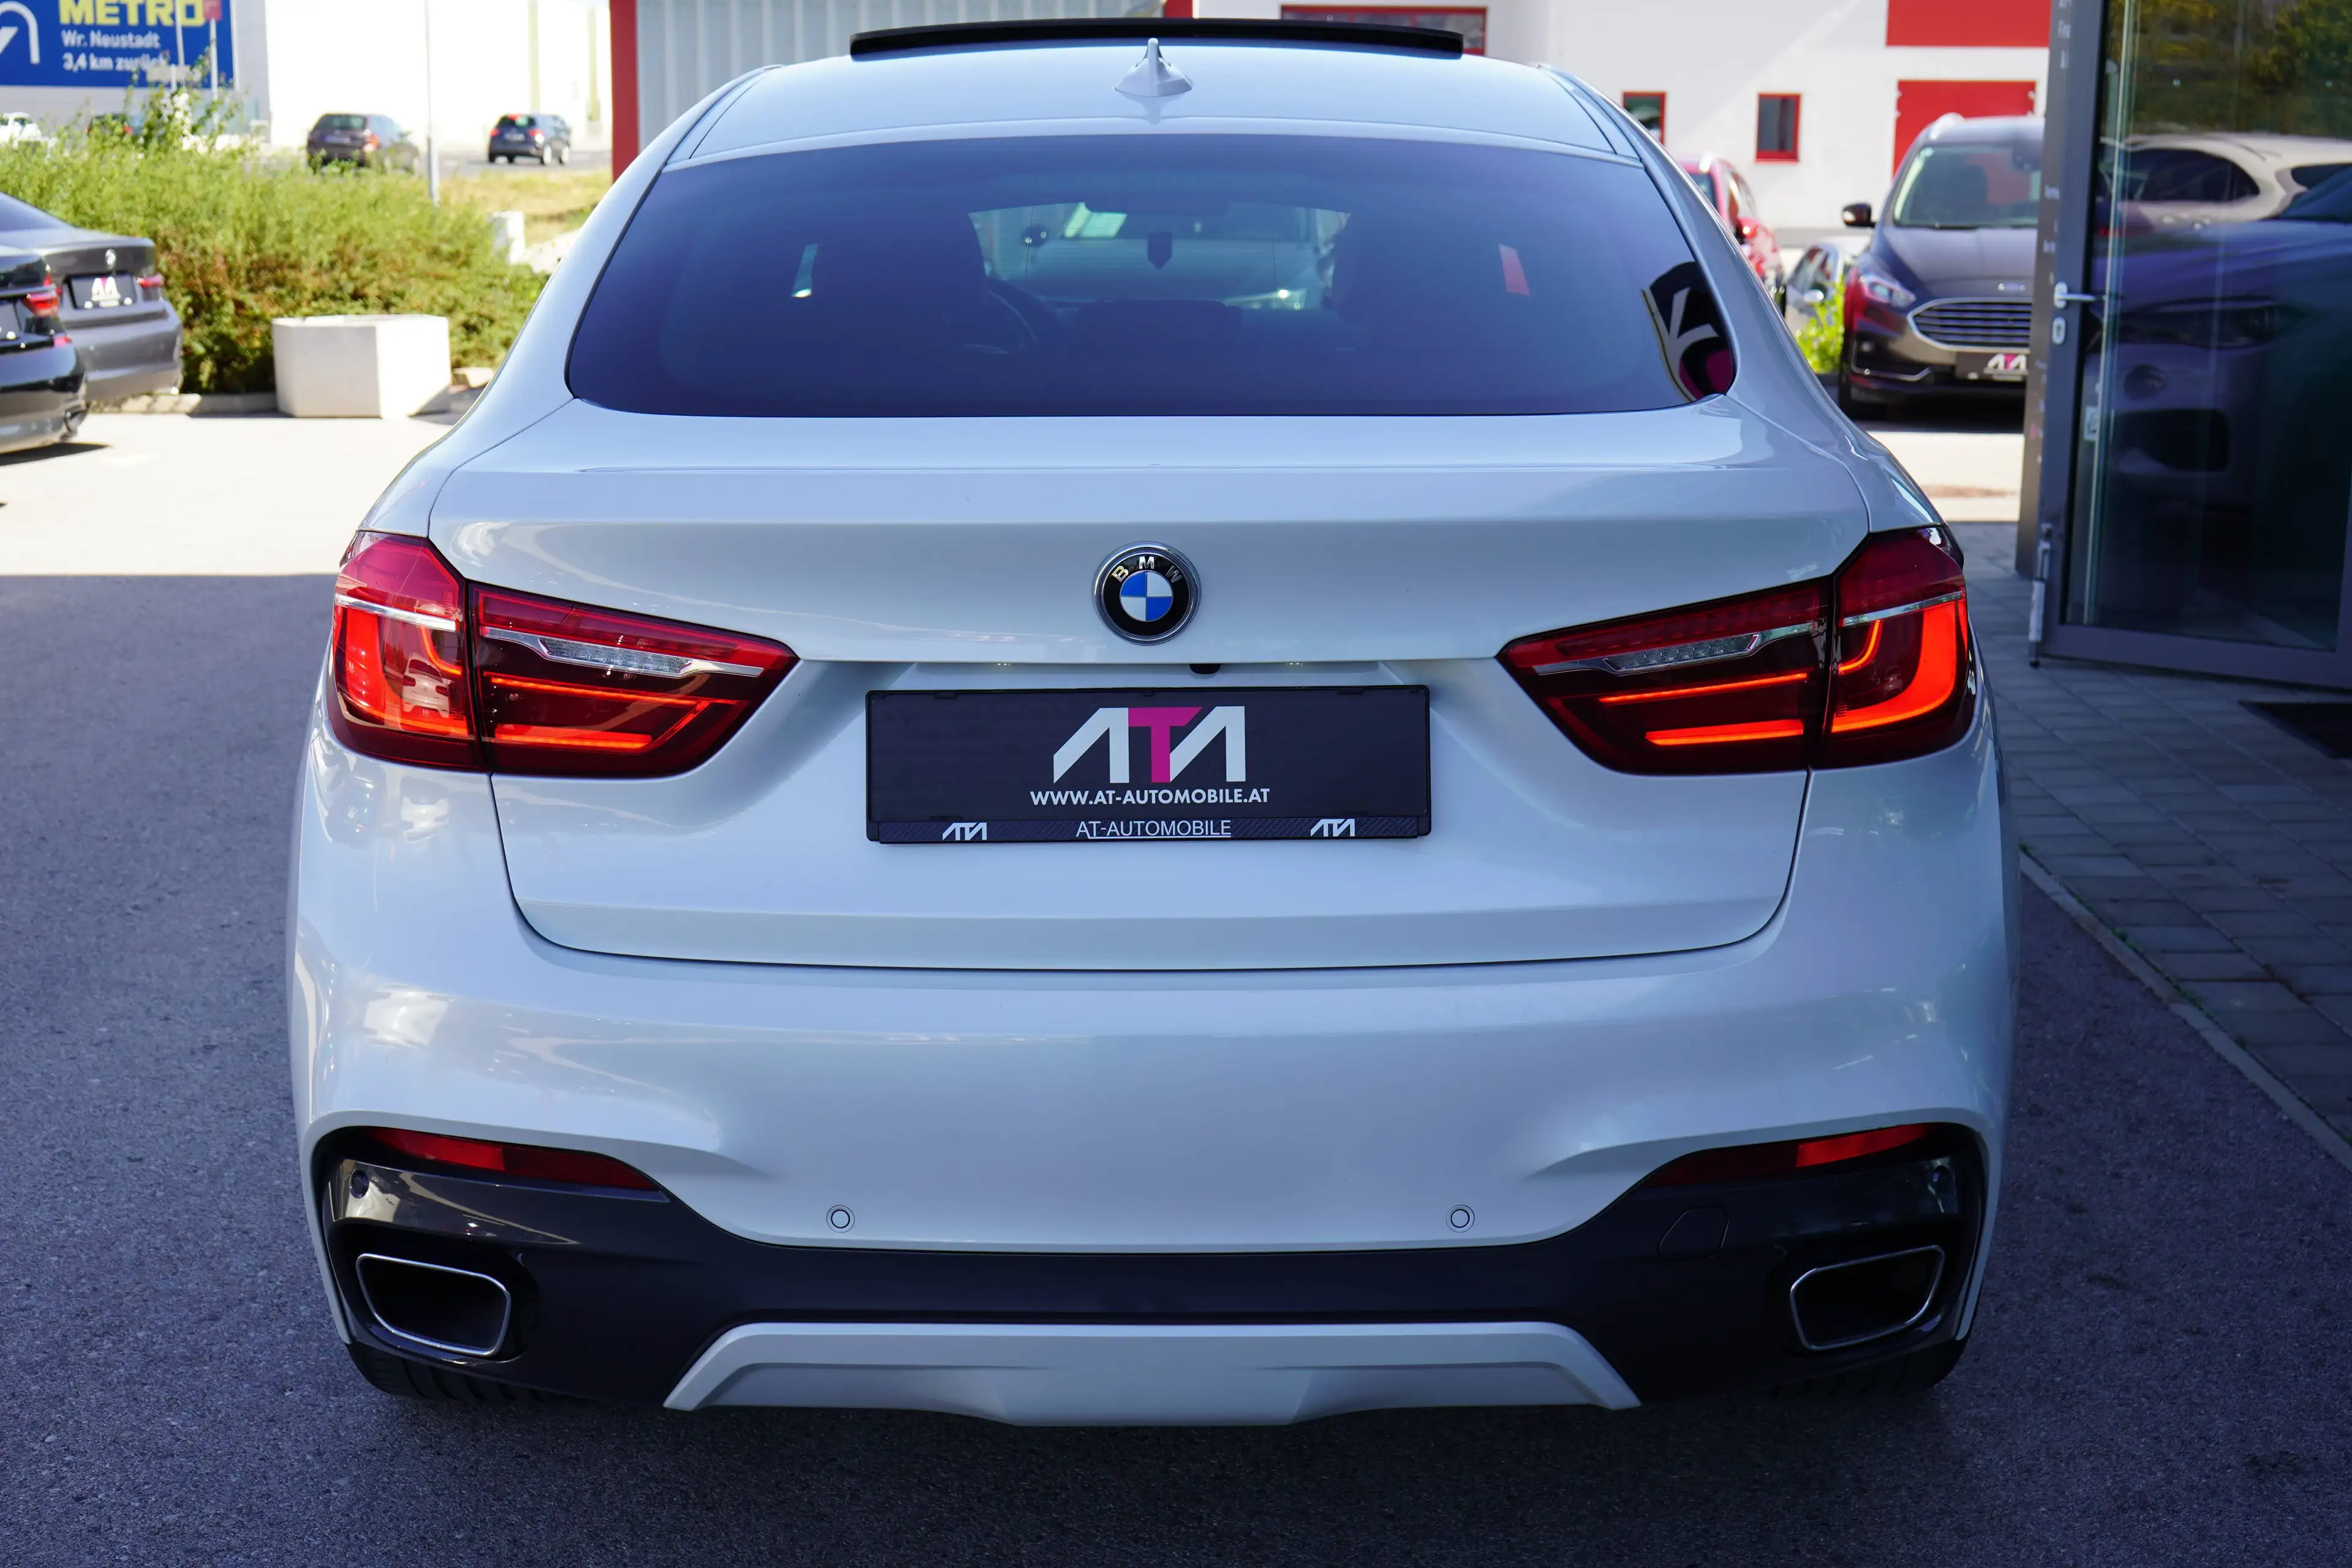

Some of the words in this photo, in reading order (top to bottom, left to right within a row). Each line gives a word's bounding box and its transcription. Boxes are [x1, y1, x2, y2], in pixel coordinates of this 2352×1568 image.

[58, 0, 206, 26] METRO
[61, 29, 88, 47] Wr.
[90, 31, 161, 48] Neustadt
[62, 52, 87, 73] 3,4
[89, 53, 114, 70] km
[1112, 556, 1182, 583] BMW
[1054, 706, 1246, 783] ATA
[1030, 788, 1270, 805] WWW.AT-AUTOMOBILE.AT
[943, 822, 987, 840] ATA
[1076, 820, 1232, 839] AT-AUTOMOBILE
[1310, 818, 1355, 837] ATA
